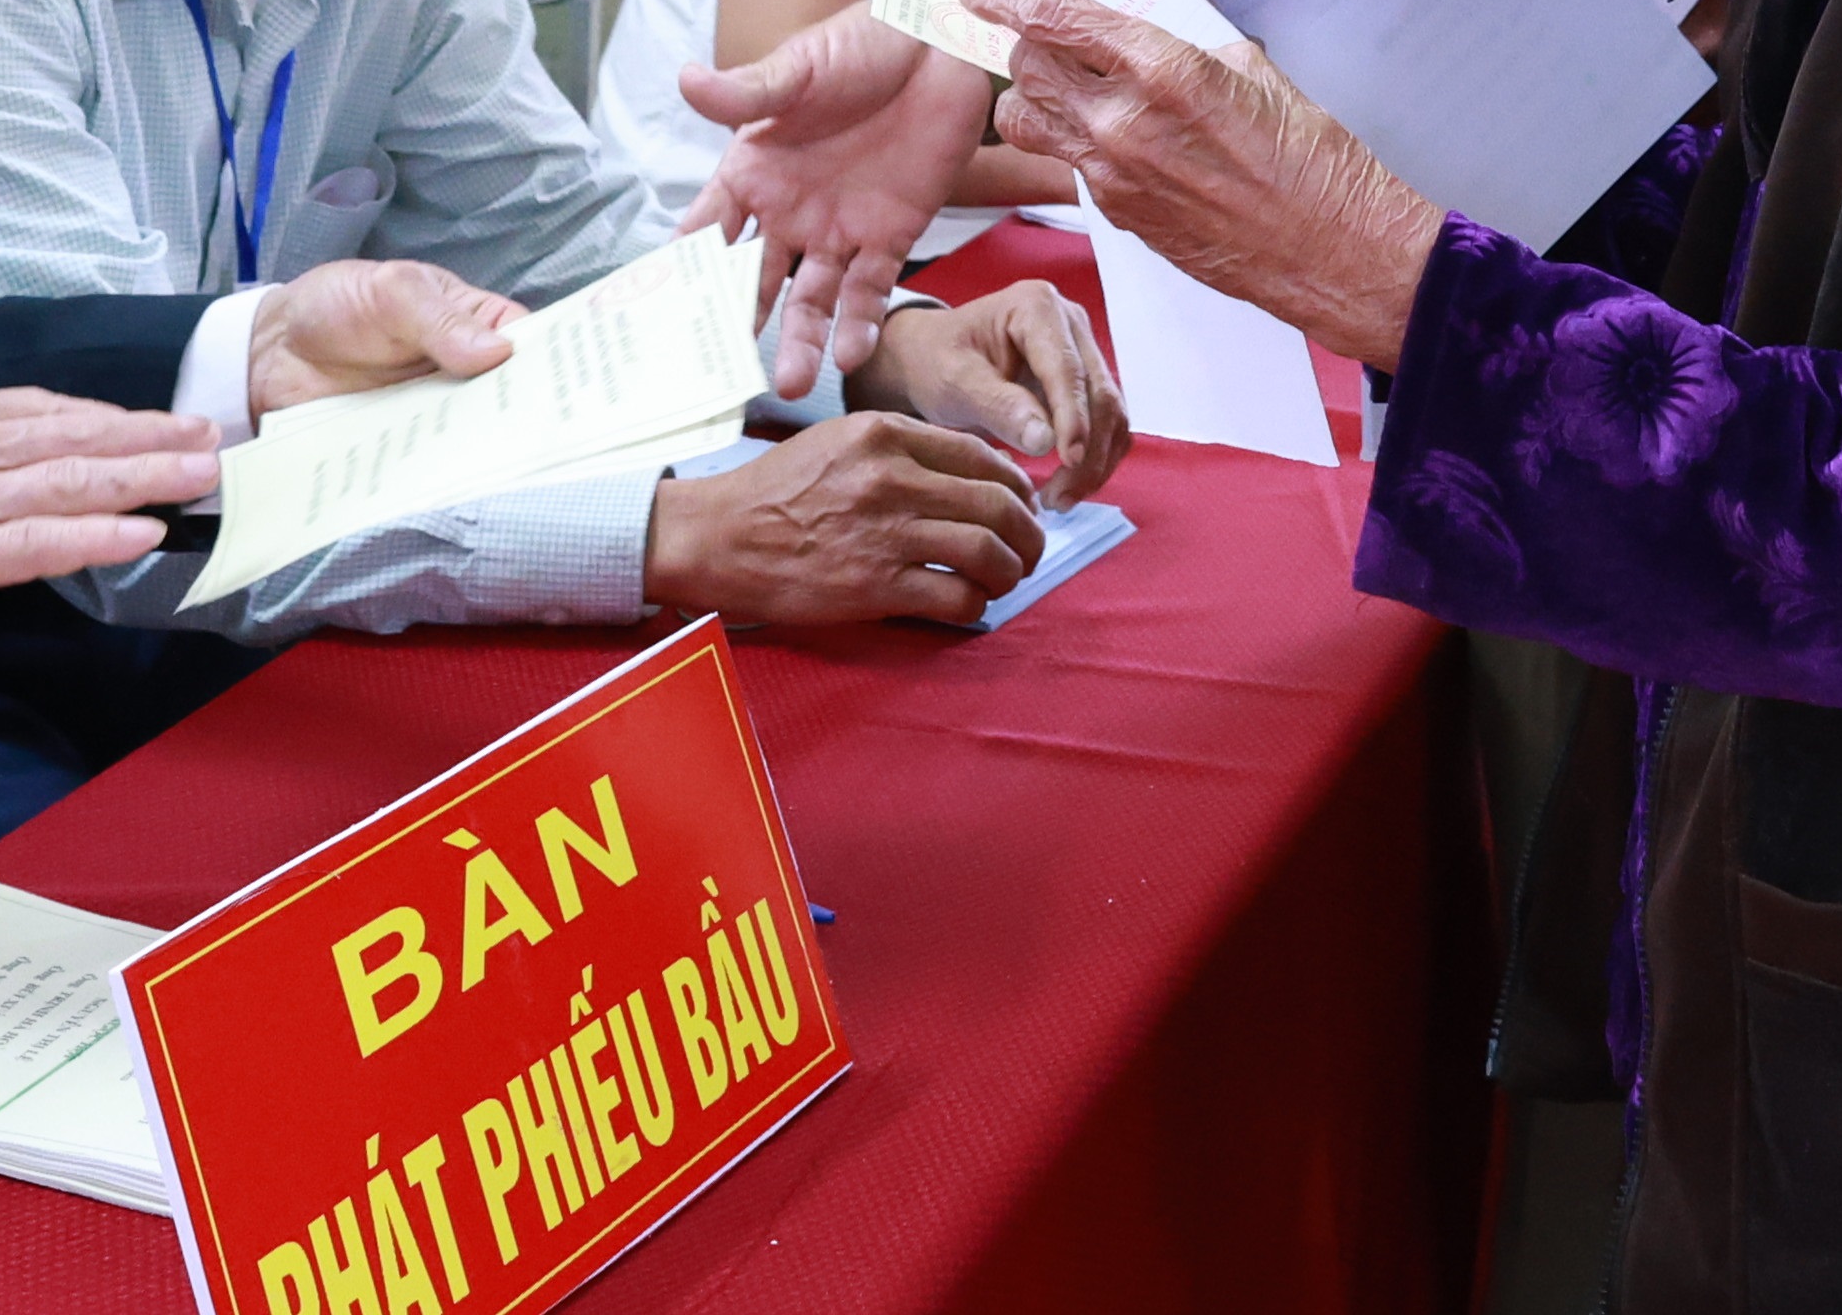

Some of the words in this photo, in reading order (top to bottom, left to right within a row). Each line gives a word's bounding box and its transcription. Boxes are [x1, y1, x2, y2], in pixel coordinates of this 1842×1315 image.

[257, 1131, 471, 1315] PHÁT
[461, 963, 675, 1266] PHIẾU
[661, 875, 801, 1111] BẦU
[331, 773, 640, 1060] BÀN
